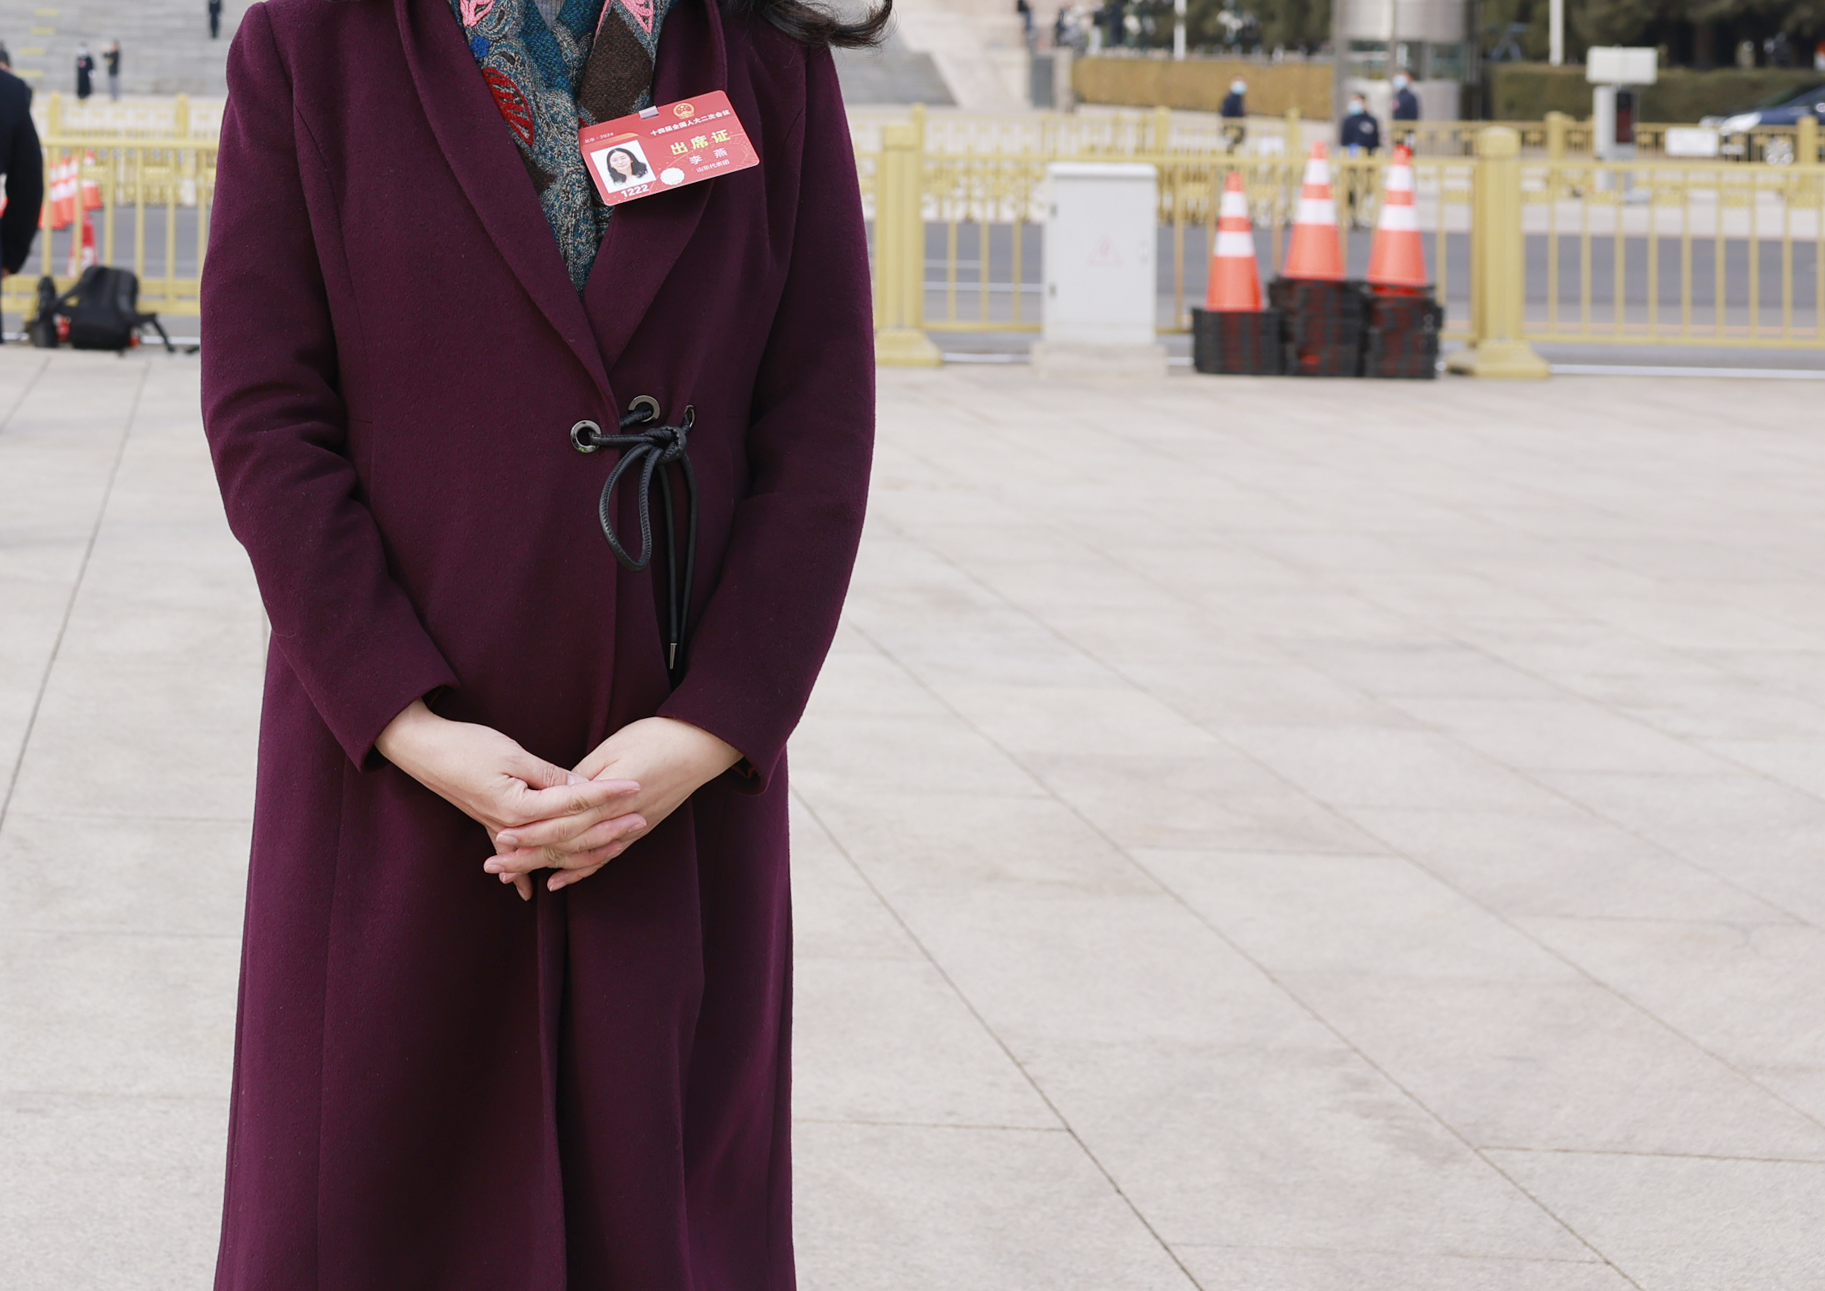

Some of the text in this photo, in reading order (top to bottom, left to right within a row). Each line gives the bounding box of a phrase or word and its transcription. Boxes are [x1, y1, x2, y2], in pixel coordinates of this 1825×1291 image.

[650, 109, 731, 136] 十四届全国人大二次会议
[670, 129, 731, 155] 出席证
[621, 184, 650, 197] 1222
